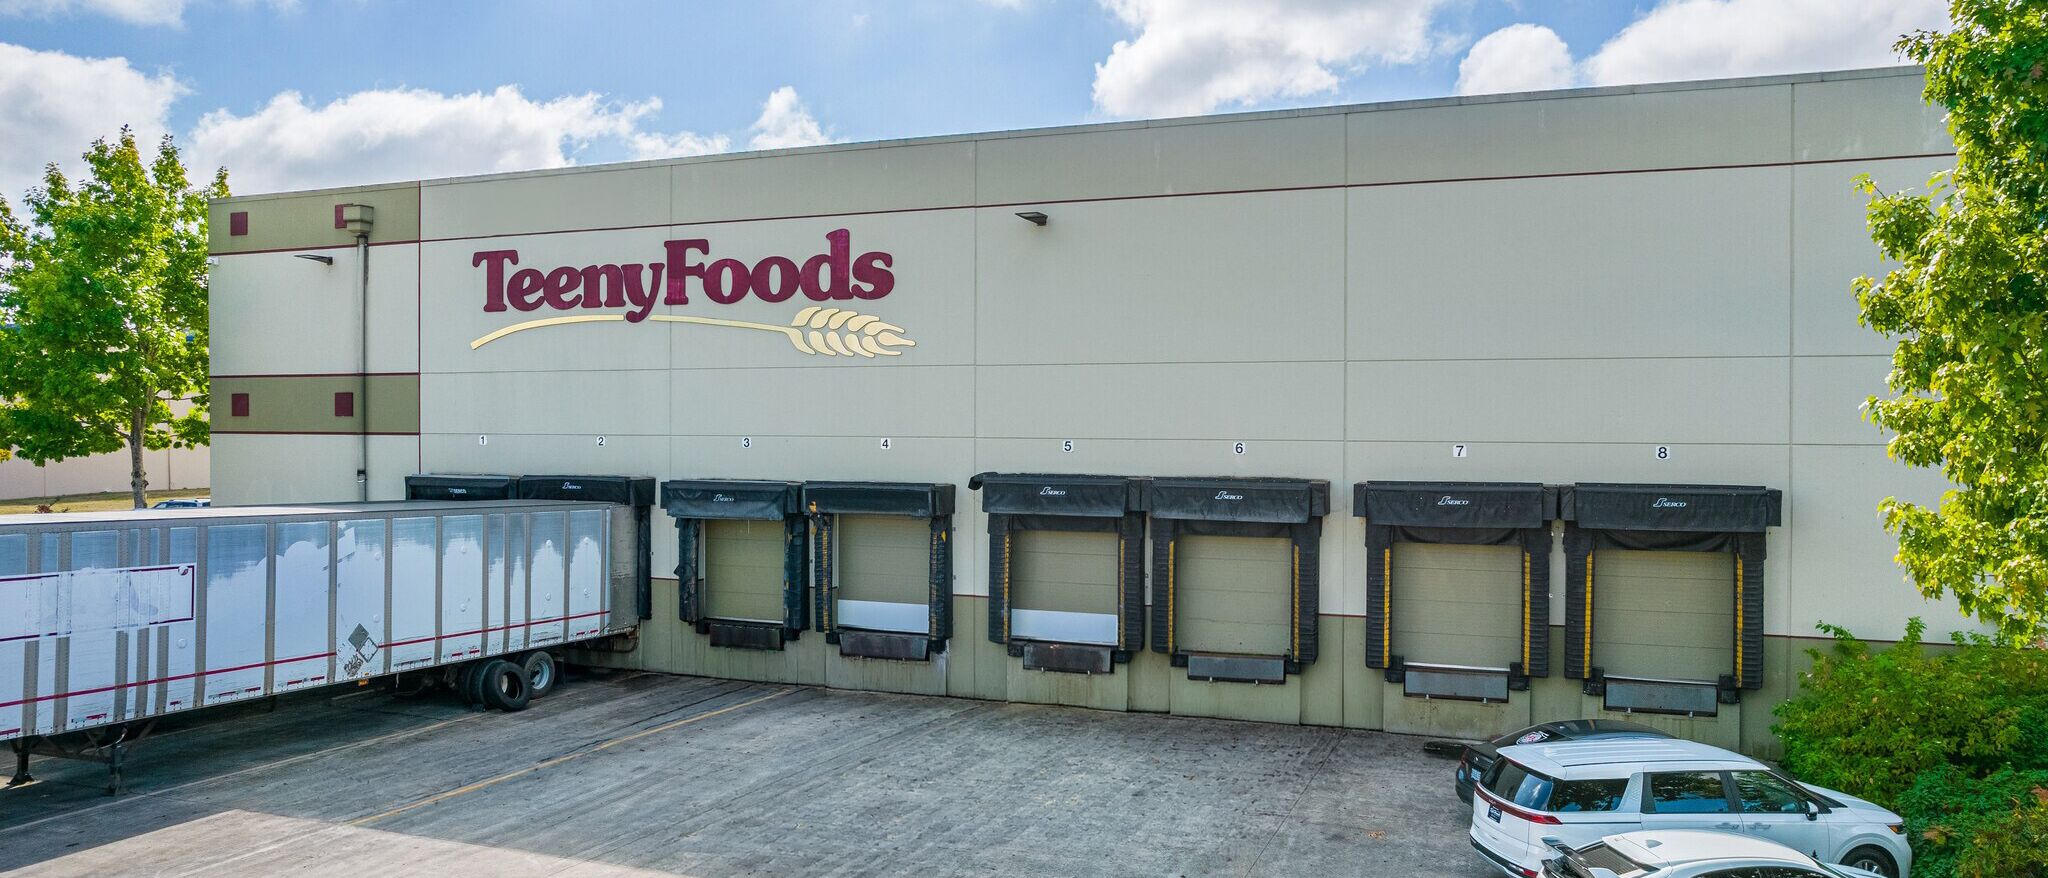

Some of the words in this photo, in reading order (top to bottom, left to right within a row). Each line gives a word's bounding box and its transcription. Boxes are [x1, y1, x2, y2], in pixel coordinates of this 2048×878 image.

[472, 228, 895, 323] TeenyFoods
[480, 436, 485, 445] 1
[598, 436, 604, 446] 2
[743, 437, 750, 448] 3
[881, 439, 889, 448] 4
[1064, 441, 1072, 451] 5
[1235, 442, 1244, 454] 6
[1455, 445, 1464, 456] 7
[1657, 446, 1668, 458] 8
